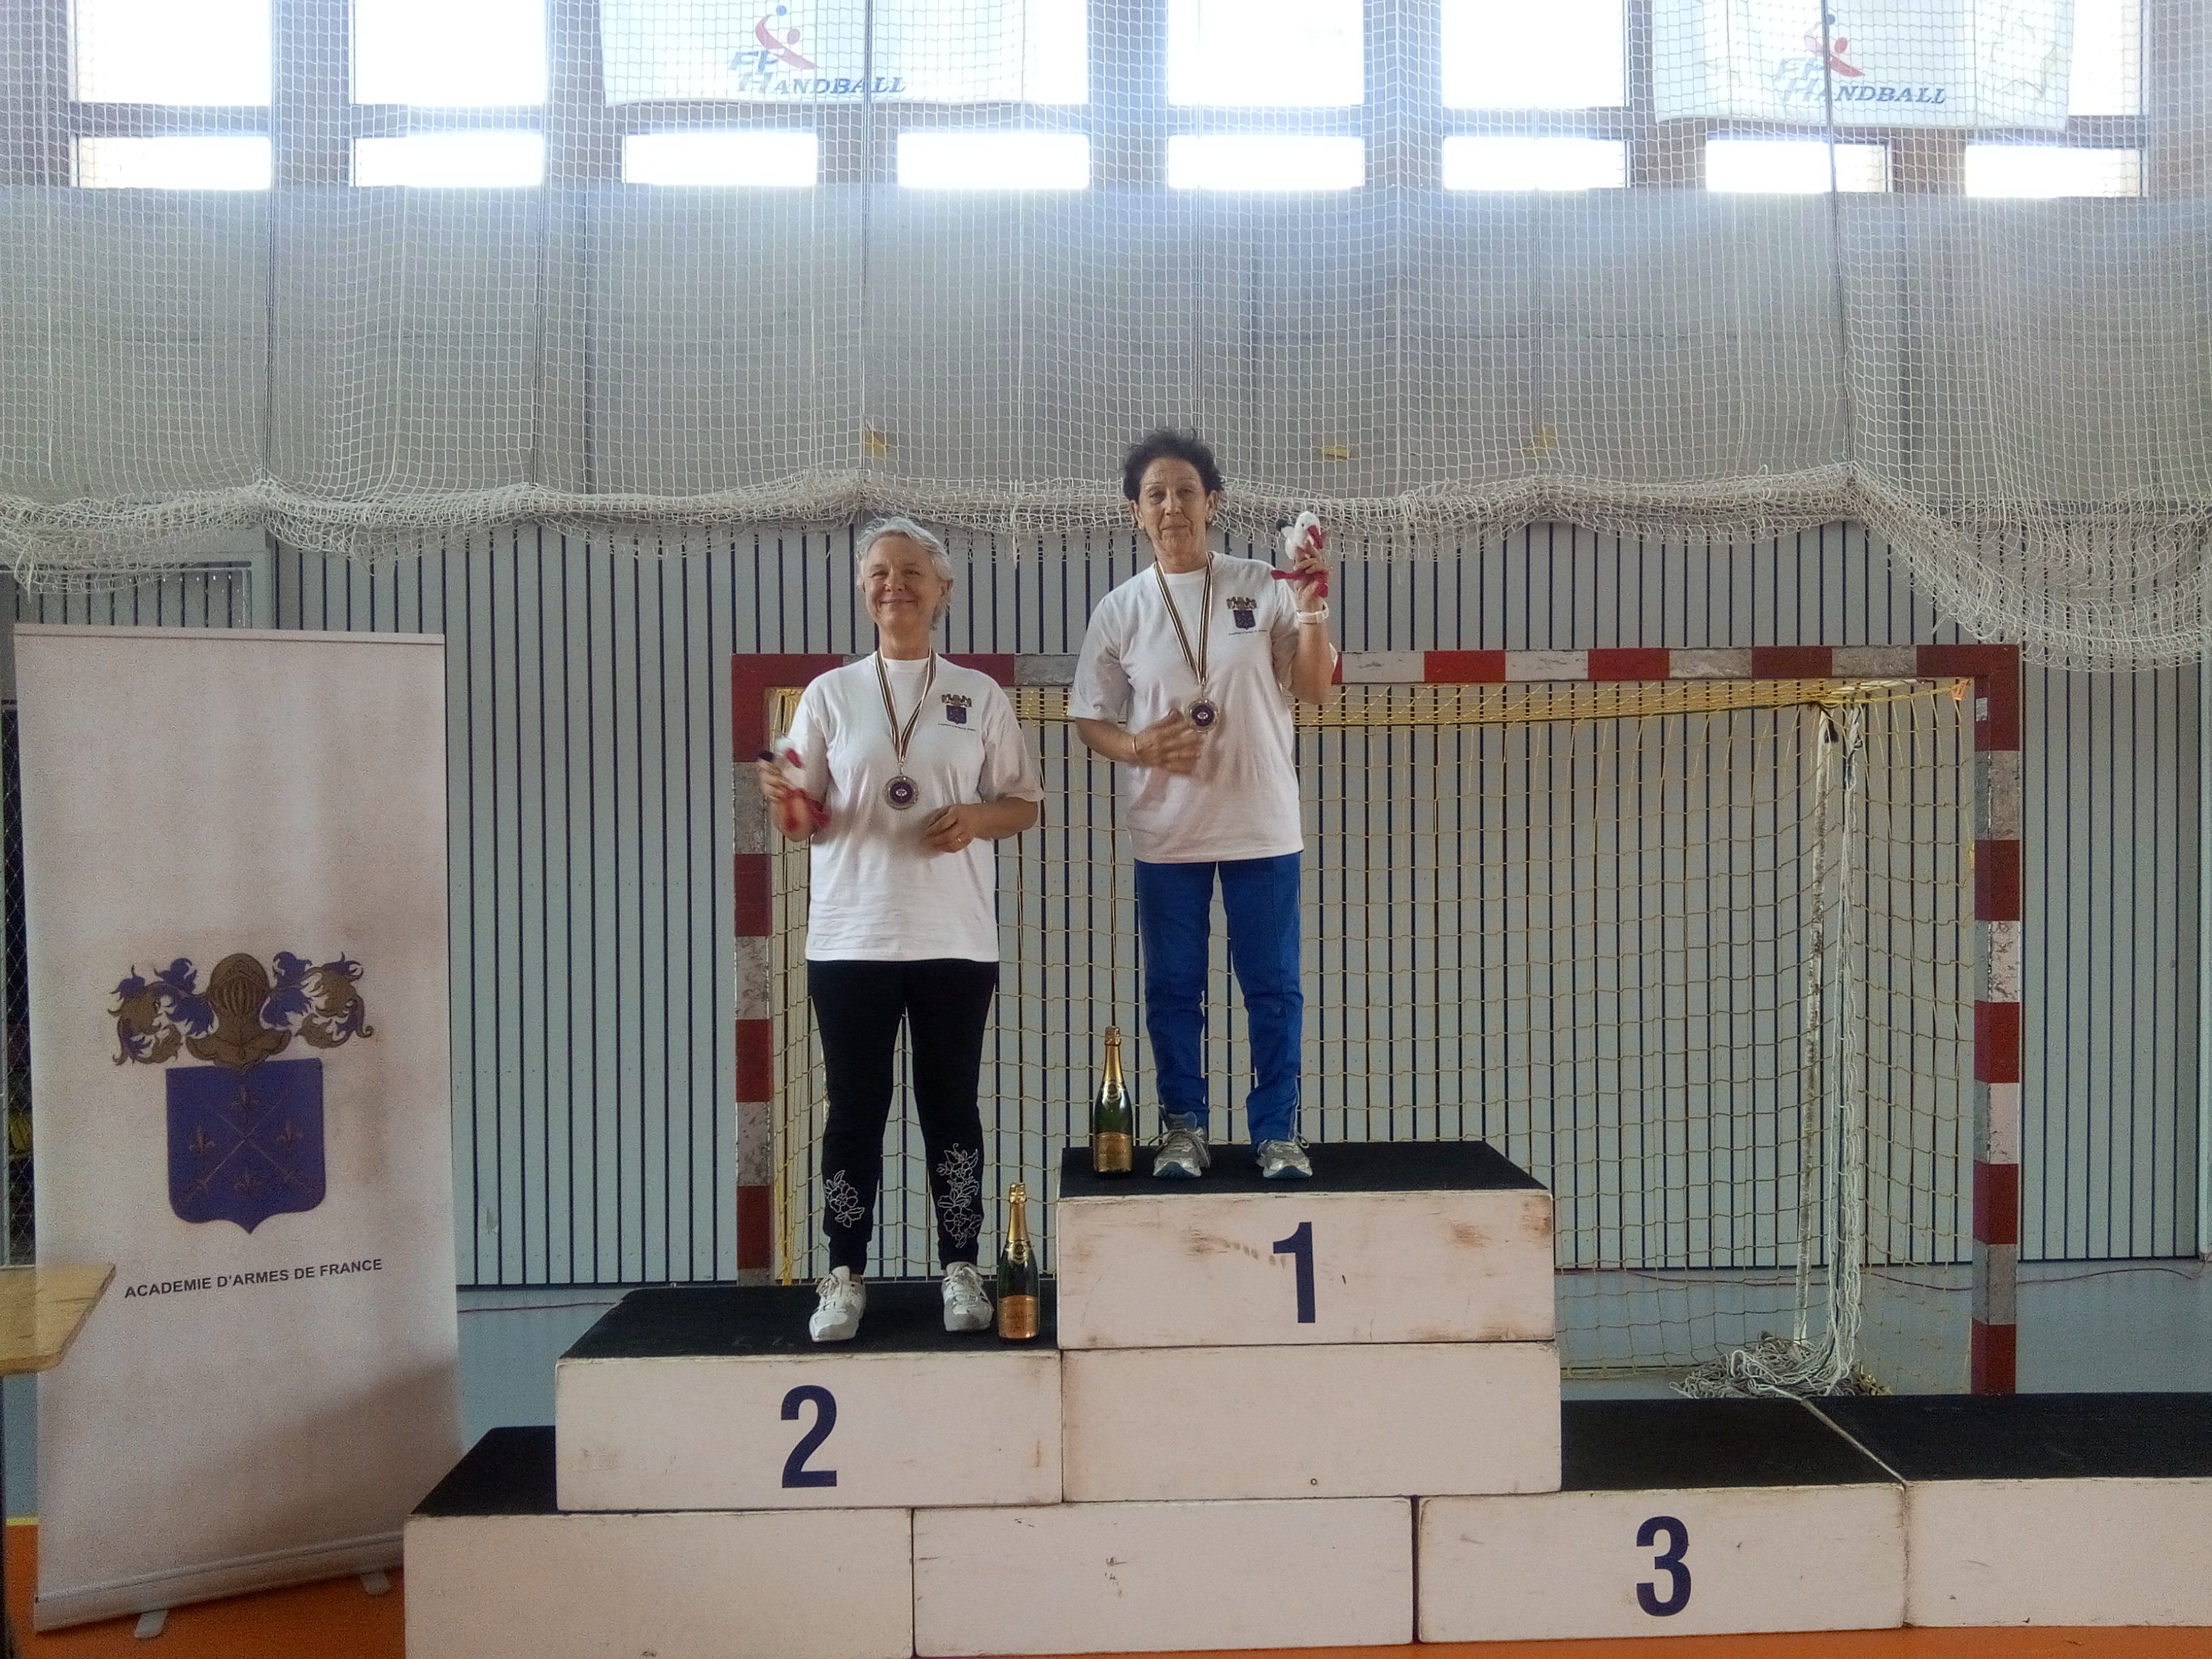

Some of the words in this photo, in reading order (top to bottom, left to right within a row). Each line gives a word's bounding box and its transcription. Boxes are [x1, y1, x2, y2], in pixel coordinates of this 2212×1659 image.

[125, 1277, 212, 1298] ACADEMIE
[217, 1269, 289, 1288] D'ARMES
[294, 1267, 315, 1279] DE
[320, 1258, 382, 1277] FRANCE
[1273, 1221, 1315, 1324] 1
[781, 1385, 837, 1489] 2
[1636, 1515, 1692, 1617] 3
